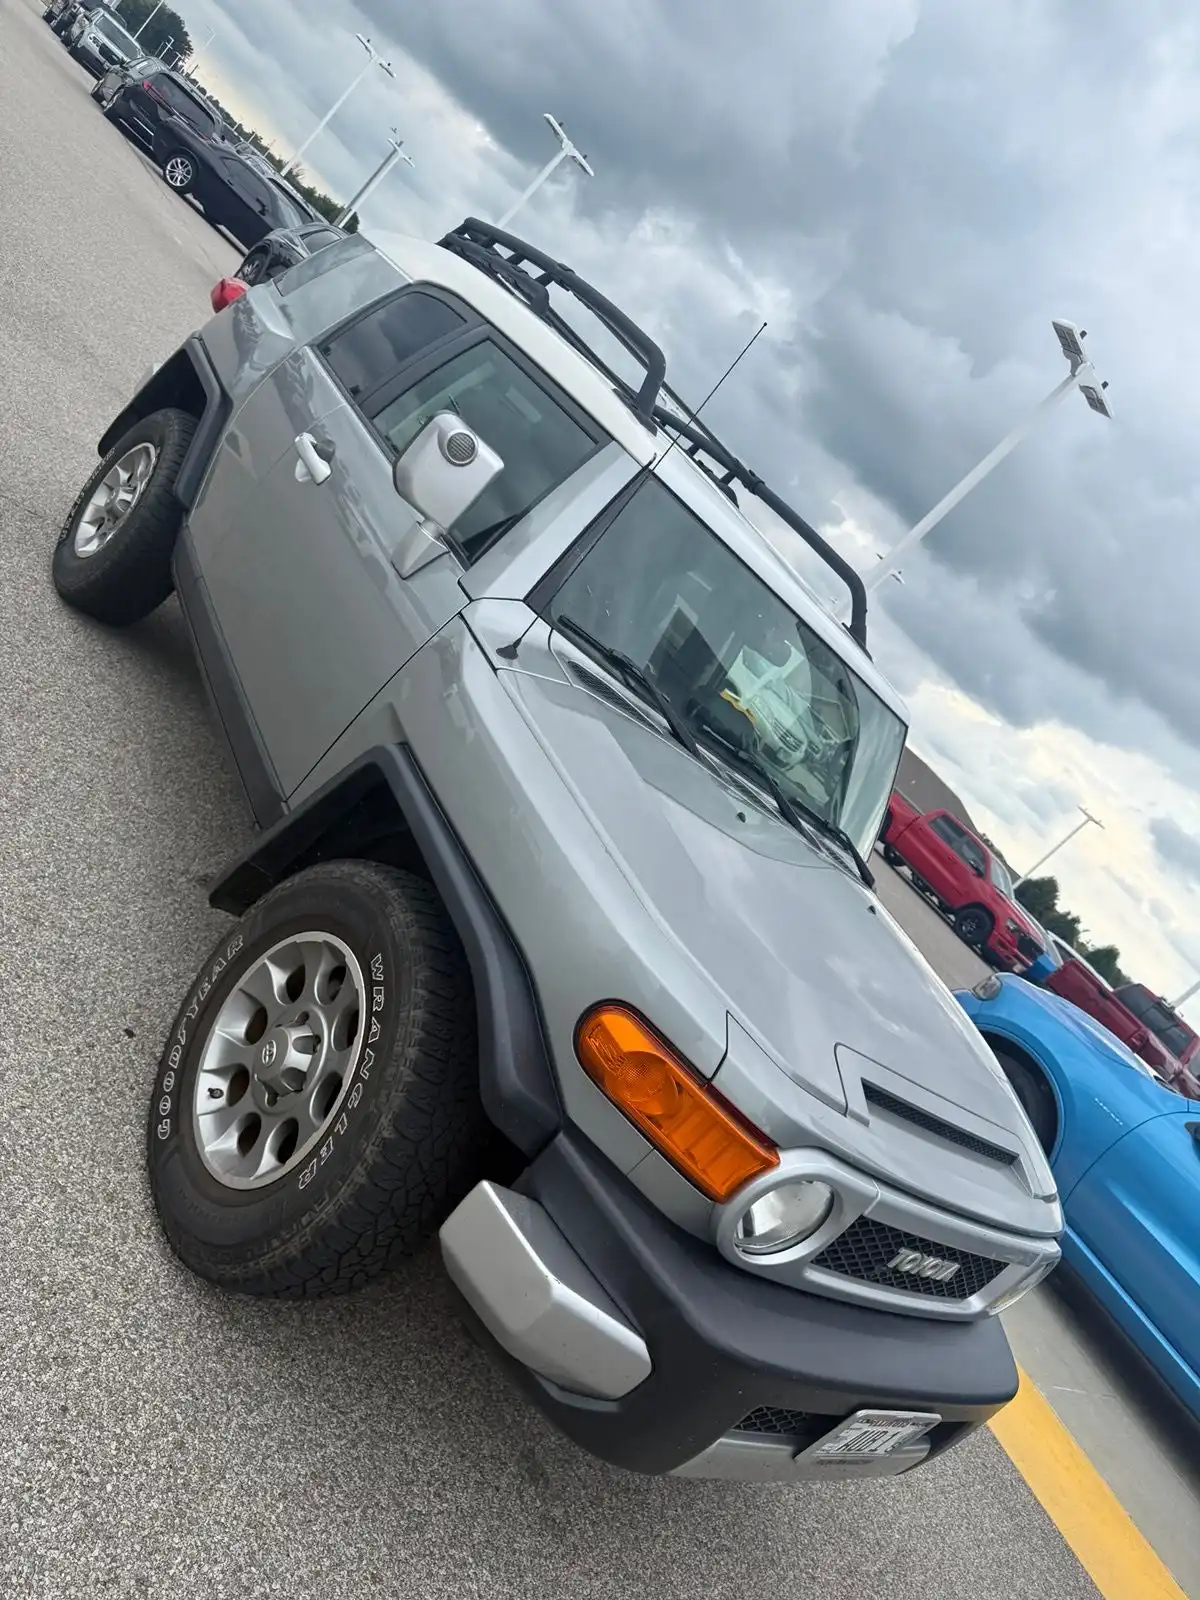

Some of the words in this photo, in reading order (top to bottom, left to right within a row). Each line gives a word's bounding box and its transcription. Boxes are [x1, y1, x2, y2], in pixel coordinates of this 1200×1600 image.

[157, 935, 244, 1140] GOODYEAR
[298, 953, 385, 1190] WRANGLER
[886, 1246, 961, 1283] TOYOTA
